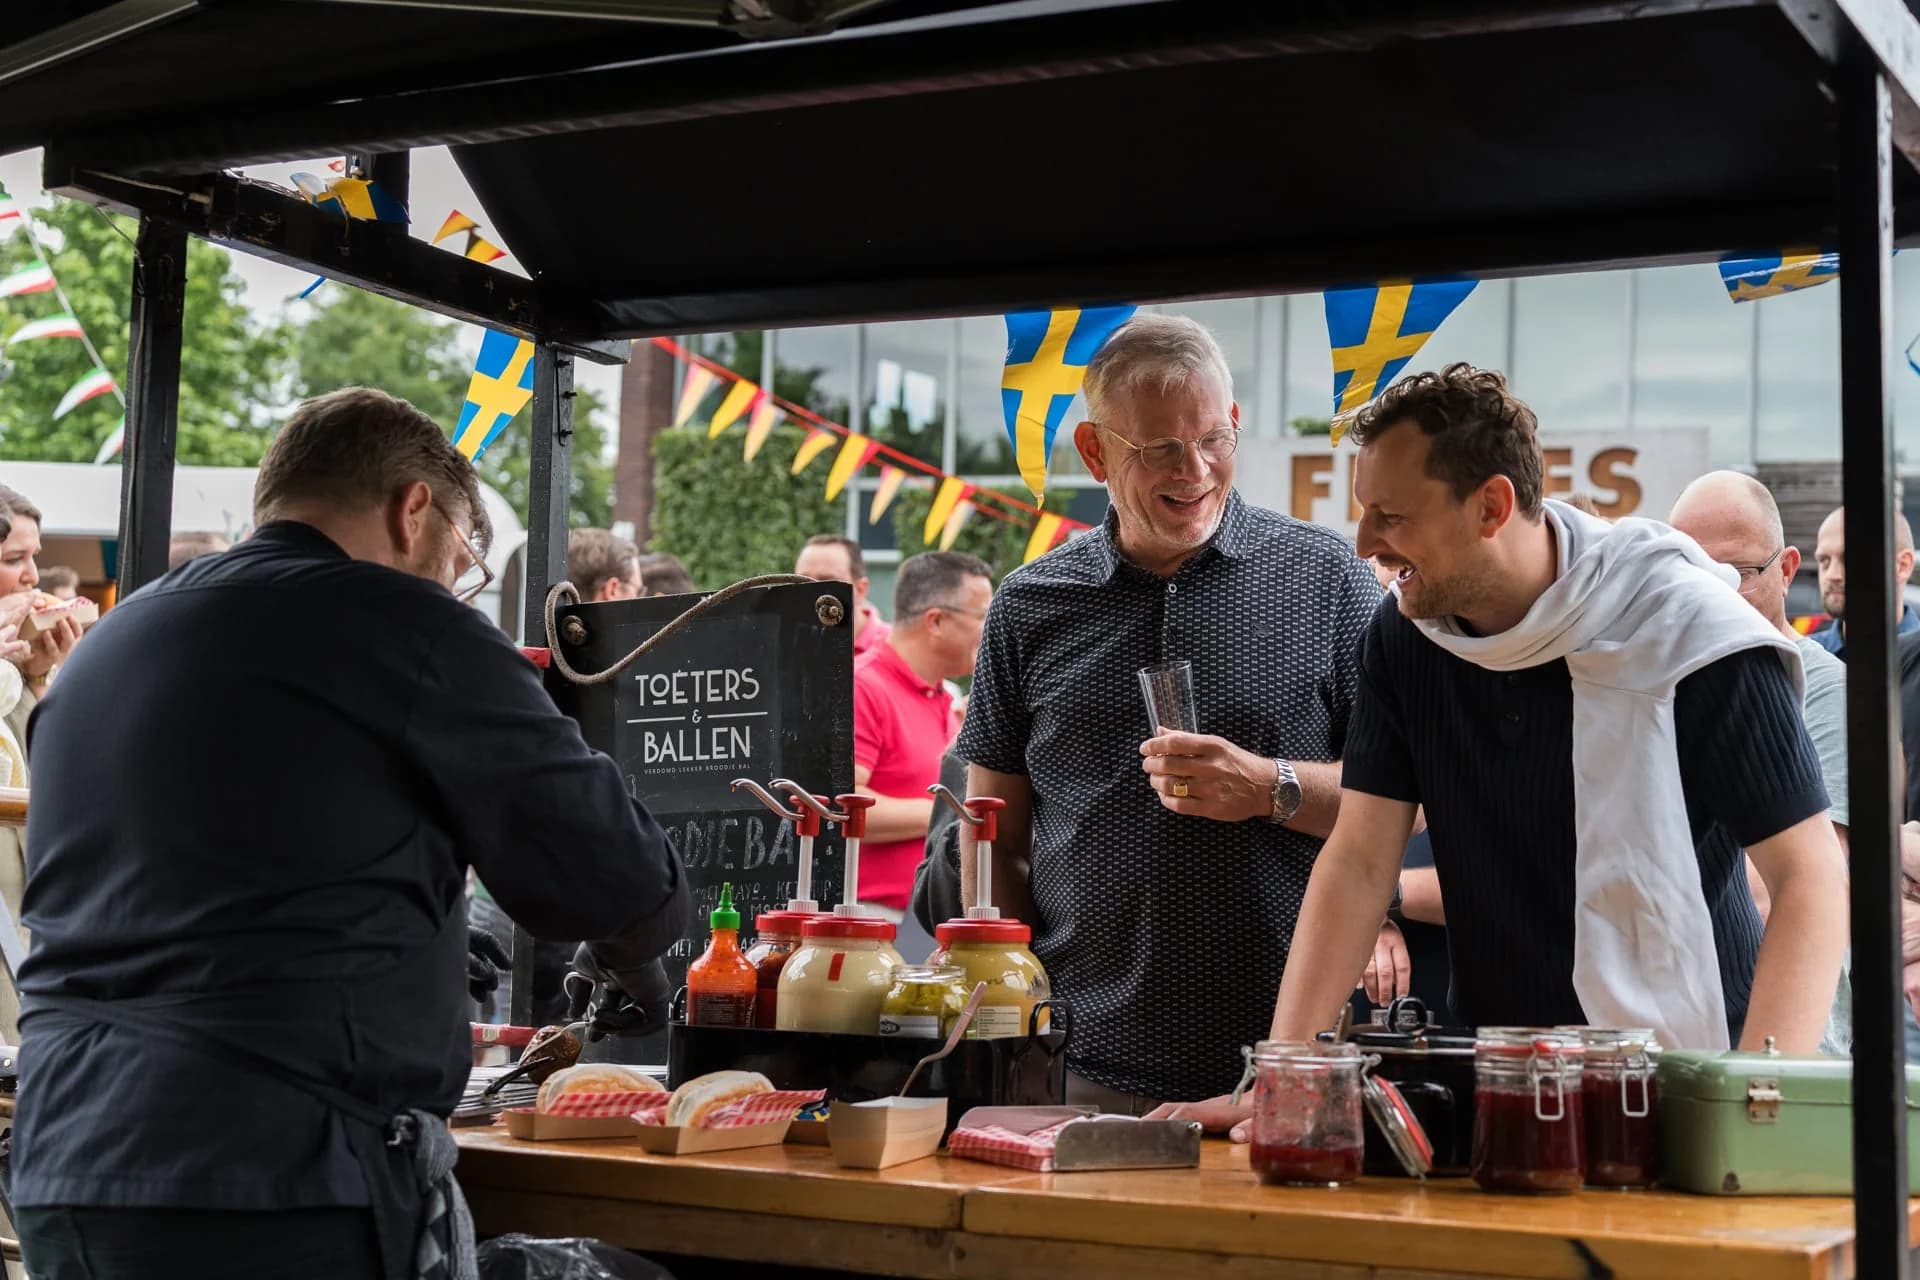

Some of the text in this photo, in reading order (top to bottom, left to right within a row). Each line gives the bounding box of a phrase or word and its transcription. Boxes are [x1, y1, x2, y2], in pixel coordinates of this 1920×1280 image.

[691, 709, 702, 724] &
[644, 725, 751, 764] BALLEN
[644, 767, 676, 775] VERDOMD
